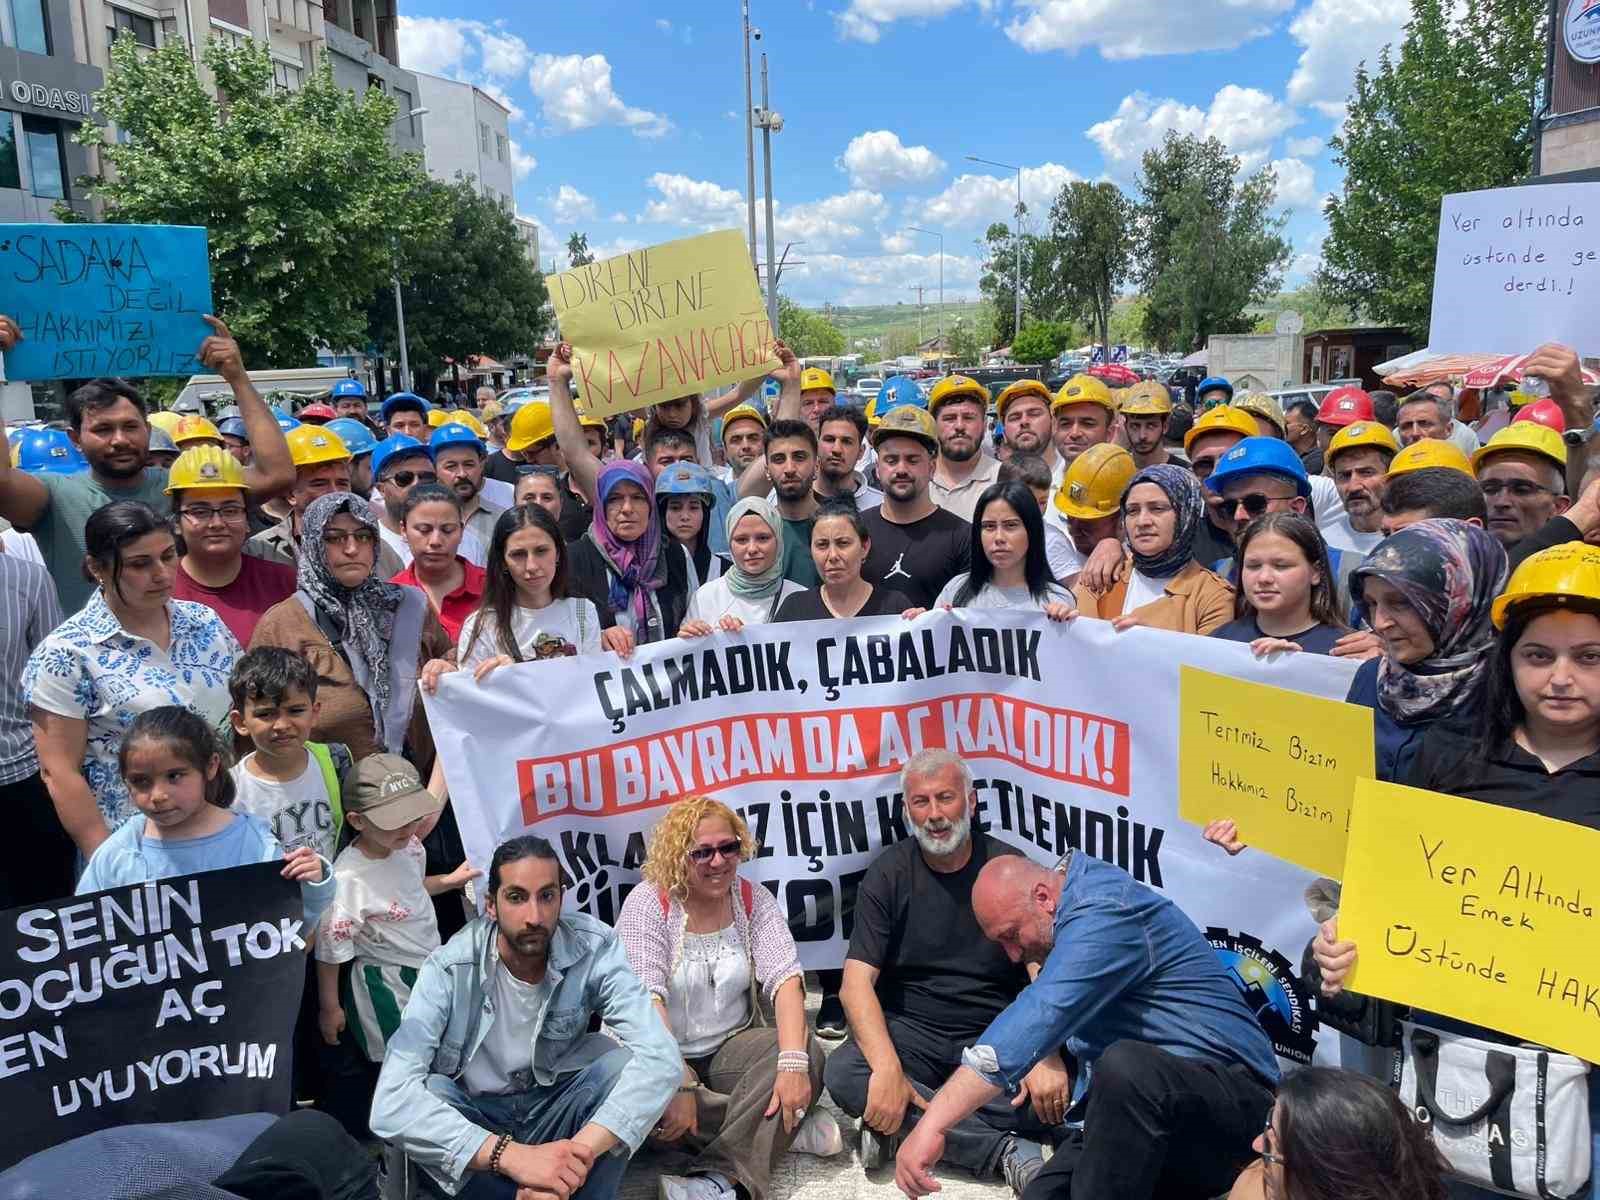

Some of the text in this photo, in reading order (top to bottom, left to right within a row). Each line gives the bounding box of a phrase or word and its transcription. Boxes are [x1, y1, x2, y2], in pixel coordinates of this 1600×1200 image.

[12, 80, 89, 115] ODASI
[1451, 205, 1585, 233] Yer altında
[14, 234, 155, 285] SADAKA
[16, 312, 154, 344] HAKKIMIZI
[593, 625, 1042, 735] ÇALMADIK, ÇABALADIK
[532, 754, 604, 816] BU
[612, 716, 795, 807] BAYRAM
[803, 712, 867, 774] DA
[942, 697, 1115, 785] KALDIK!
[1199, 710, 1337, 771] Terimiz Bizim
[389, 777, 409, 793] NYC
[1286, 786, 1333, 824] Bizim
[781, 789, 869, 872] İÇİN
[1419, 834, 1593, 918] Yer Altında
[16, 879, 203, 963] SENİN
[1461, 894, 1536, 931] Emek
[211, 917, 306, 967] TOK
[1385, 924, 1508, 985] Üstünde
[155, 980, 226, 1028] AÇ
[1274, 1042, 1312, 1063] UNION
[52, 1042, 277, 1117] UYUYORUM
